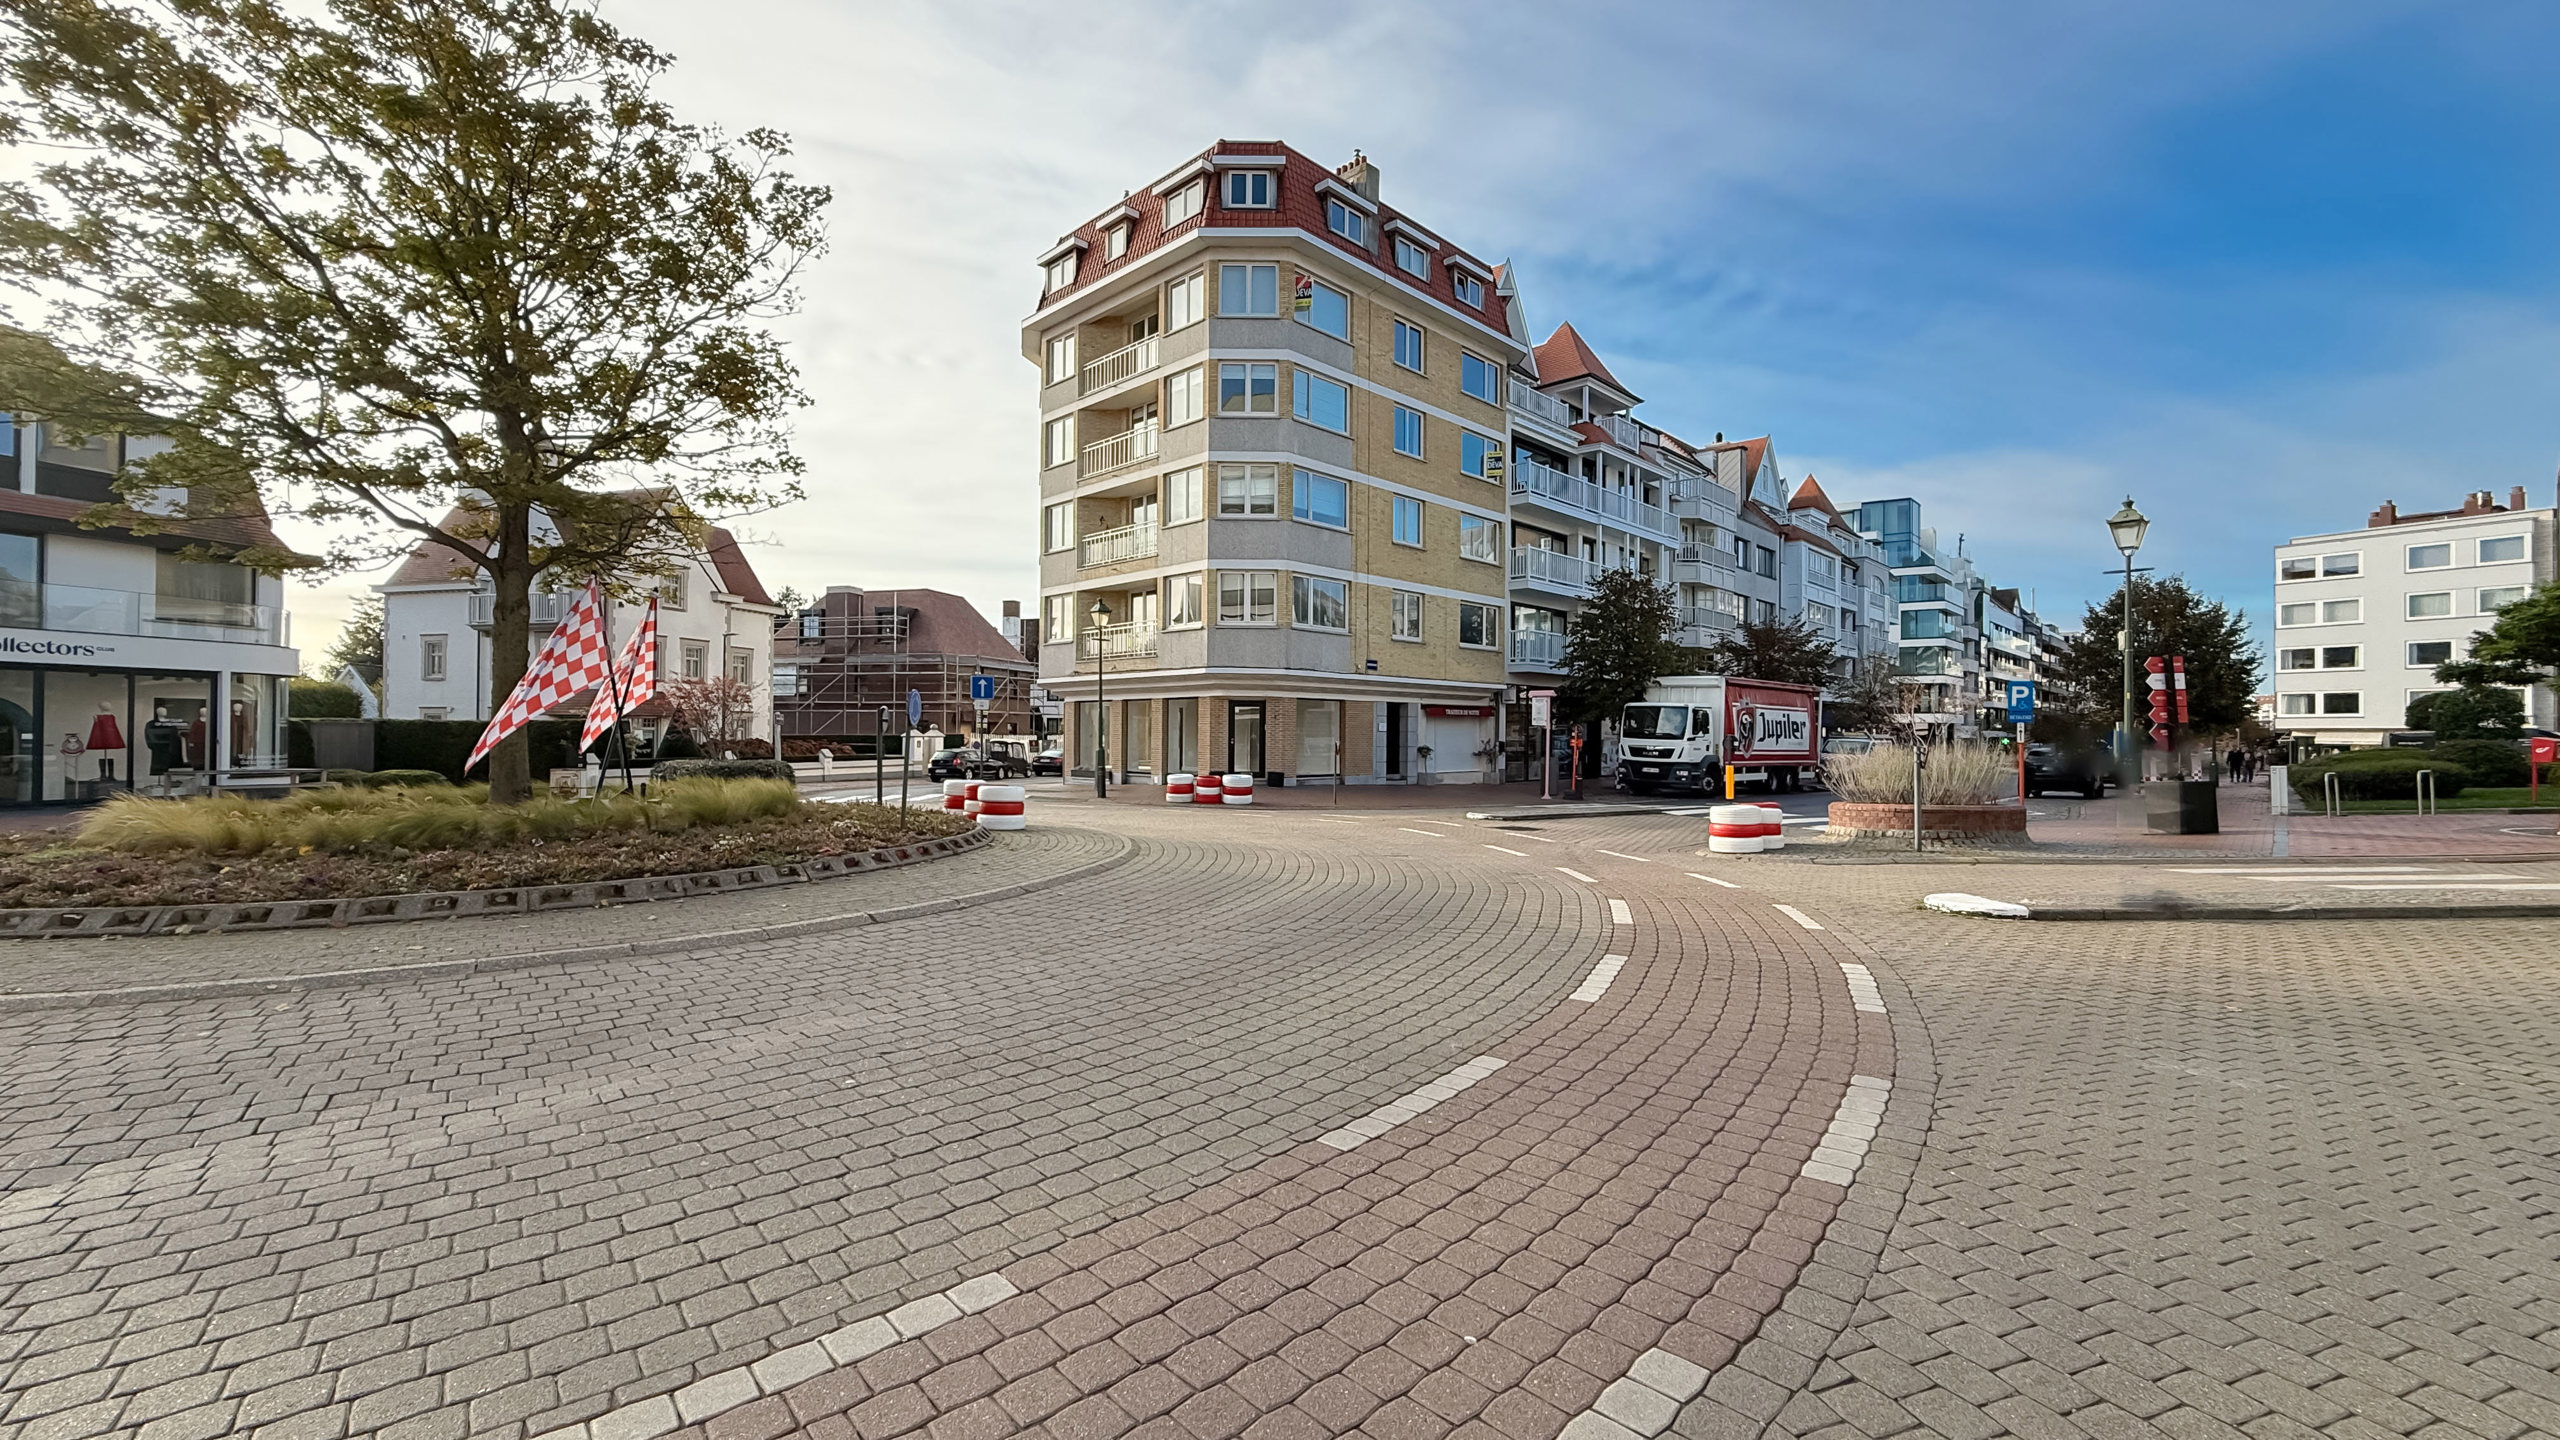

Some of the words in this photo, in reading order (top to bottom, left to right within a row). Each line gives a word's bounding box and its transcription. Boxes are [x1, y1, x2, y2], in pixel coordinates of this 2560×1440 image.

[1488, 461, 1502, 469] DEVA
[0, 636, 95, 657] llectors
[2011, 685, 2029, 707] P
[1757, 712, 1806, 746] Jupiler
